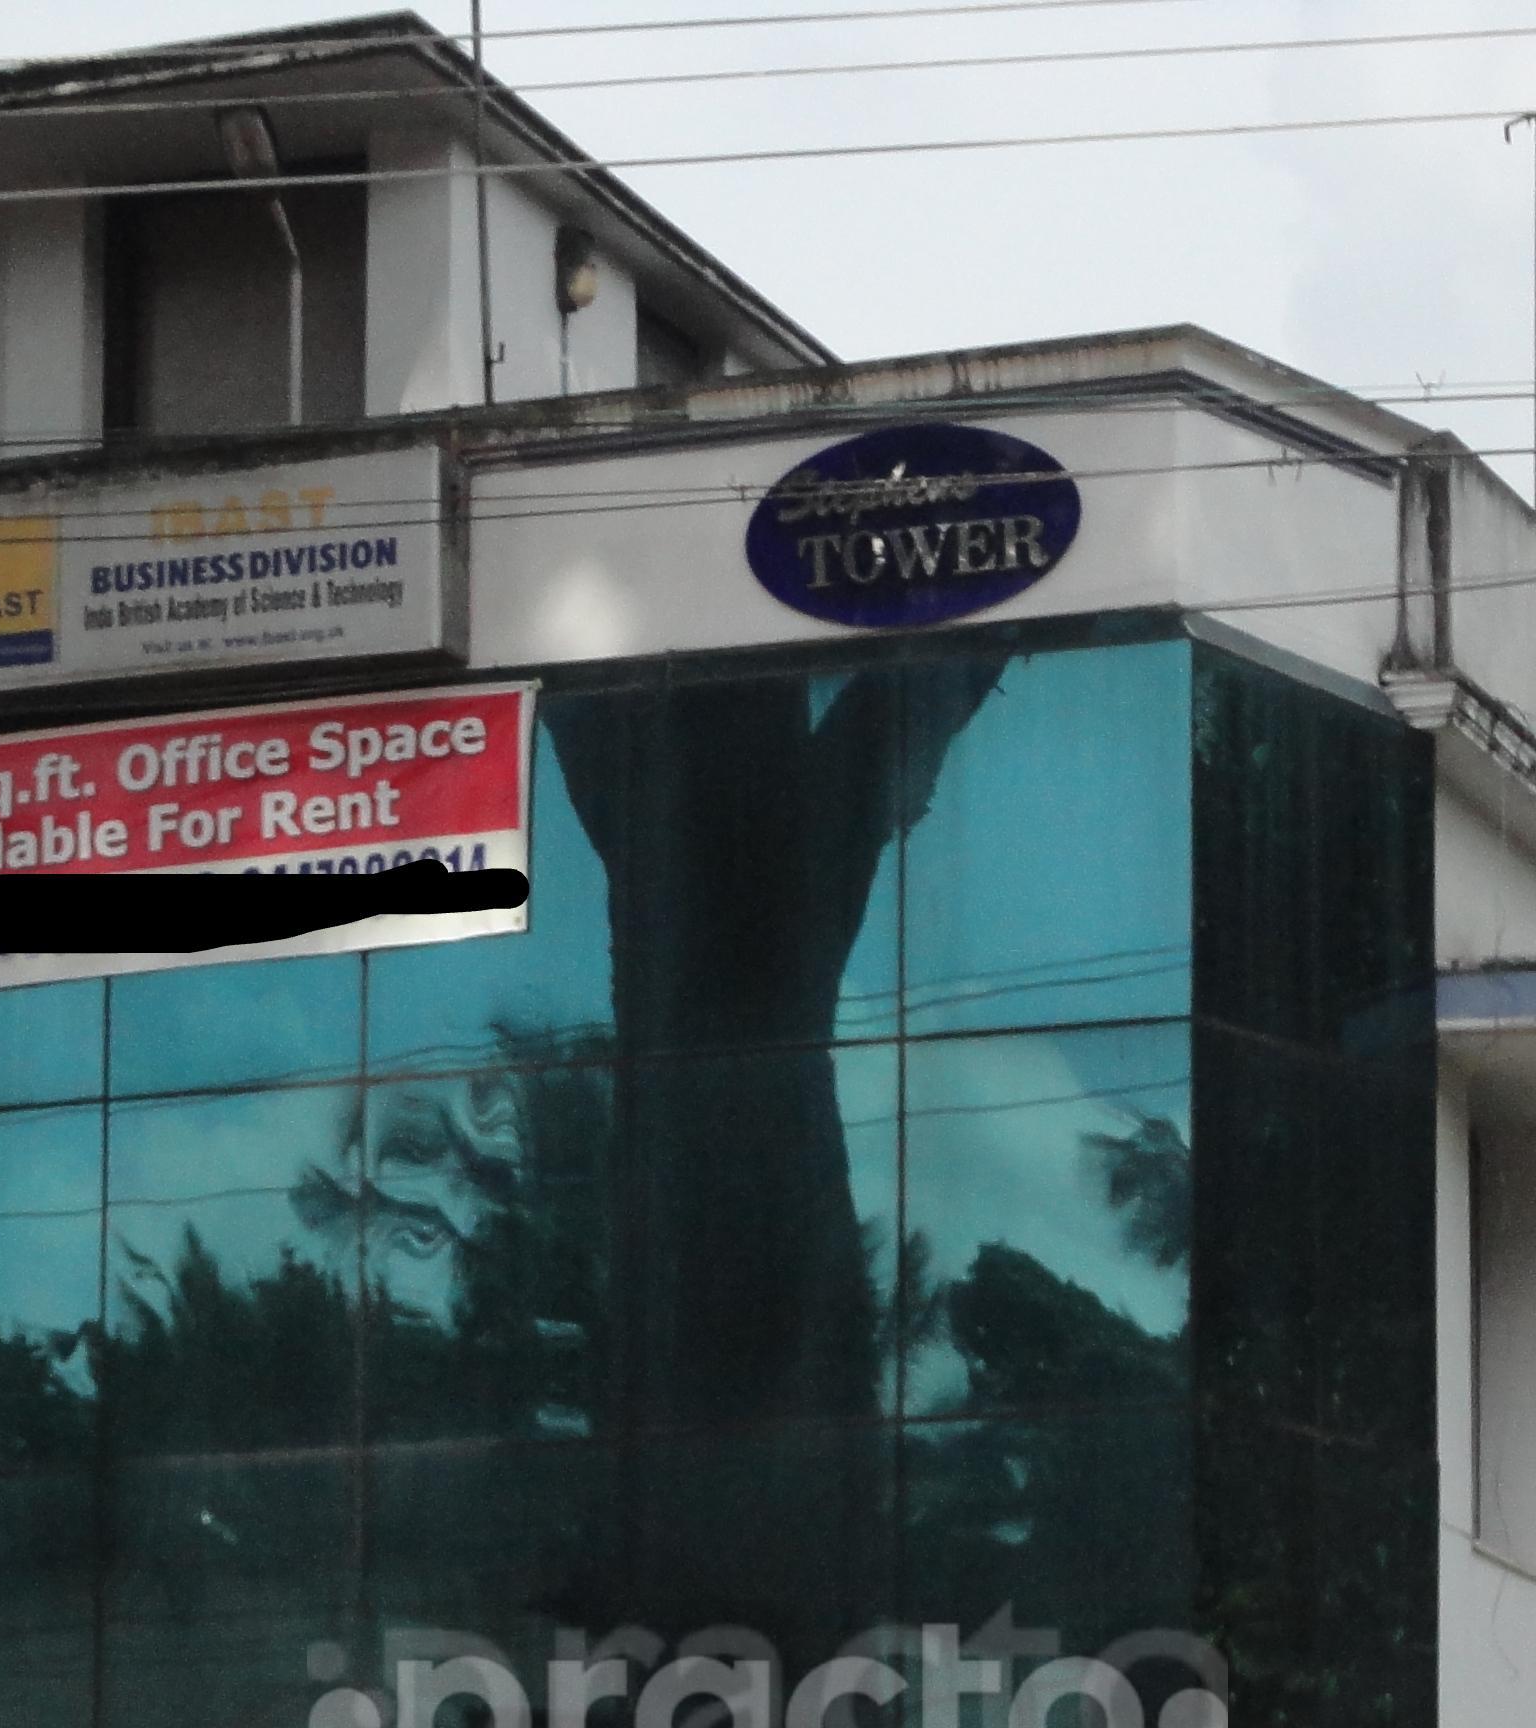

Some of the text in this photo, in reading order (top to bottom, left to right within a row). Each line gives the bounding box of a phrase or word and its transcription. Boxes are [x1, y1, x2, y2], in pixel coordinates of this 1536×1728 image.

[798, 514, 1050, 589] TOWER
[117, 733, 289, 795] Office
[310, 713, 487, 776] Space
[147, 800, 243, 853] For
[262, 779, 401, 841] Rent
